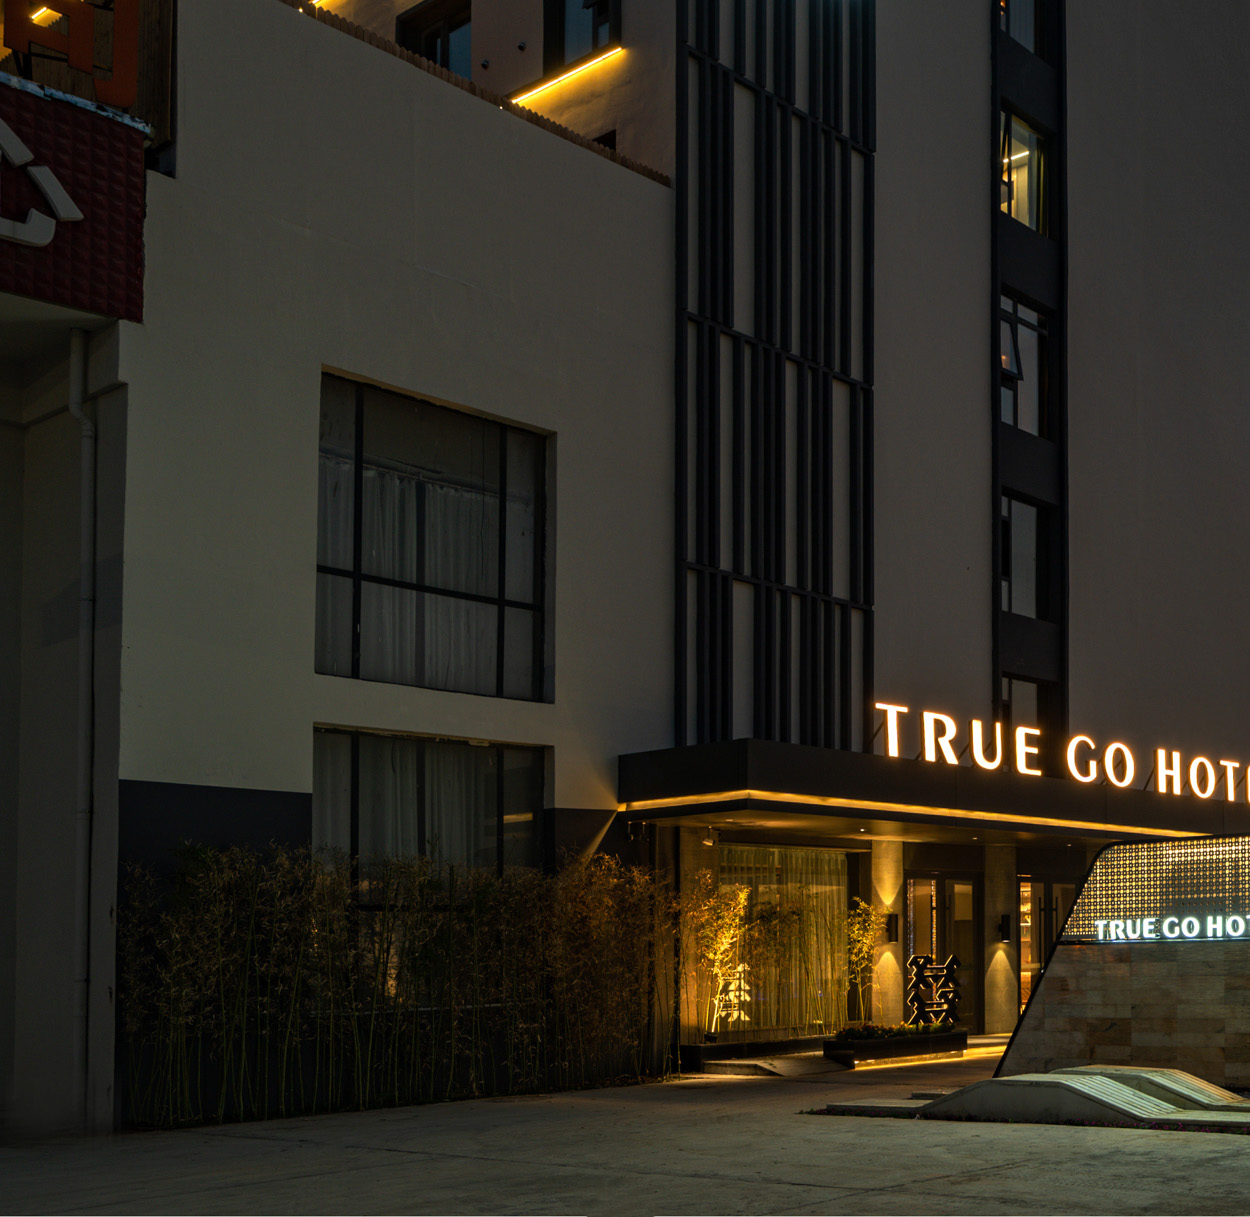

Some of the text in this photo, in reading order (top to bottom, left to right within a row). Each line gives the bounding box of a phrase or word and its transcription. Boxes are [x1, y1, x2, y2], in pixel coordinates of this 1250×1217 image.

[874, 701, 1043, 777] TRUE
[1065, 734, 1136, 789] GO
[1094, 918, 1157, 941] TRUE
[1162, 916, 1201, 939] GO
